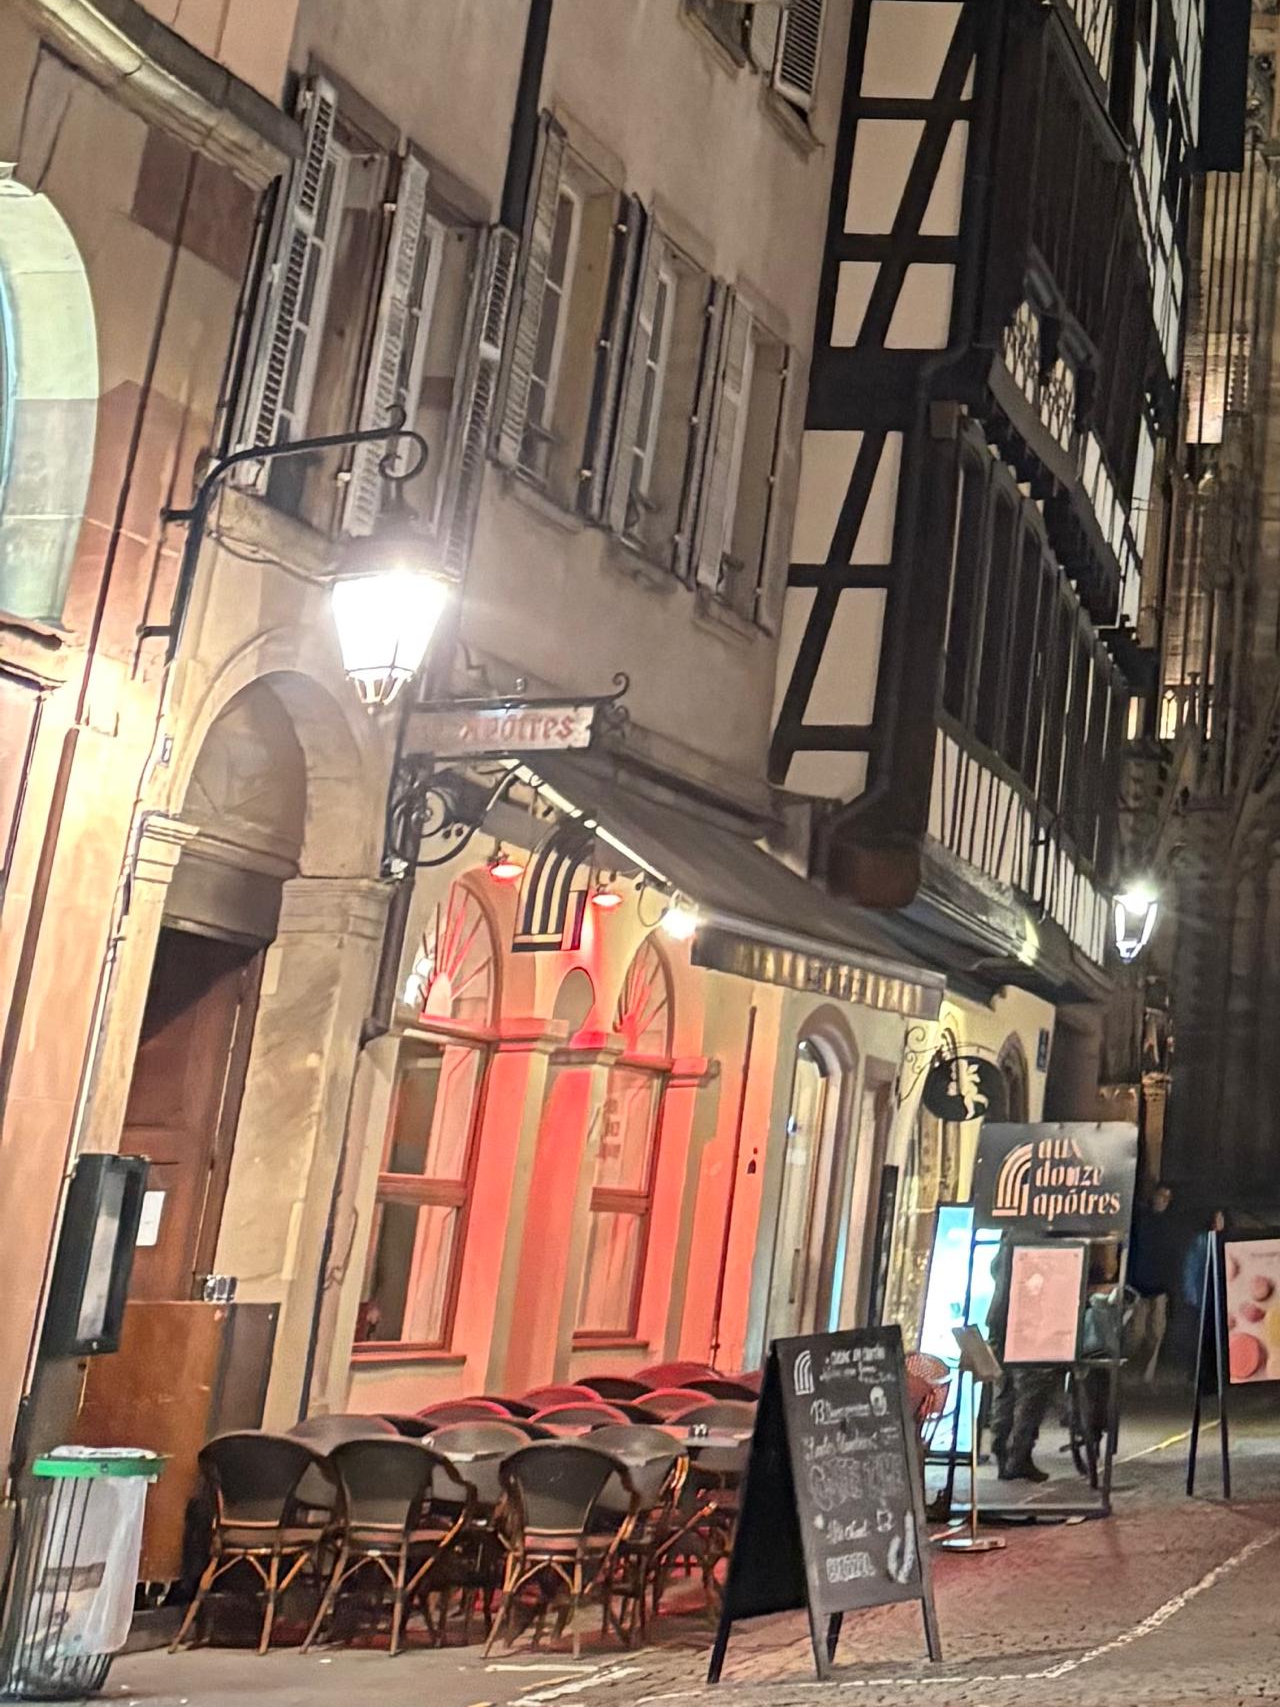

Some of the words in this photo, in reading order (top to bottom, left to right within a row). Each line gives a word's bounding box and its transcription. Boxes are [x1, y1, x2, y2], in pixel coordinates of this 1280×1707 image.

[1037, 1138, 1083, 1159] aux
[1035, 1160, 1105, 1188] douze
[1032, 1188, 1121, 1222] apôtres
